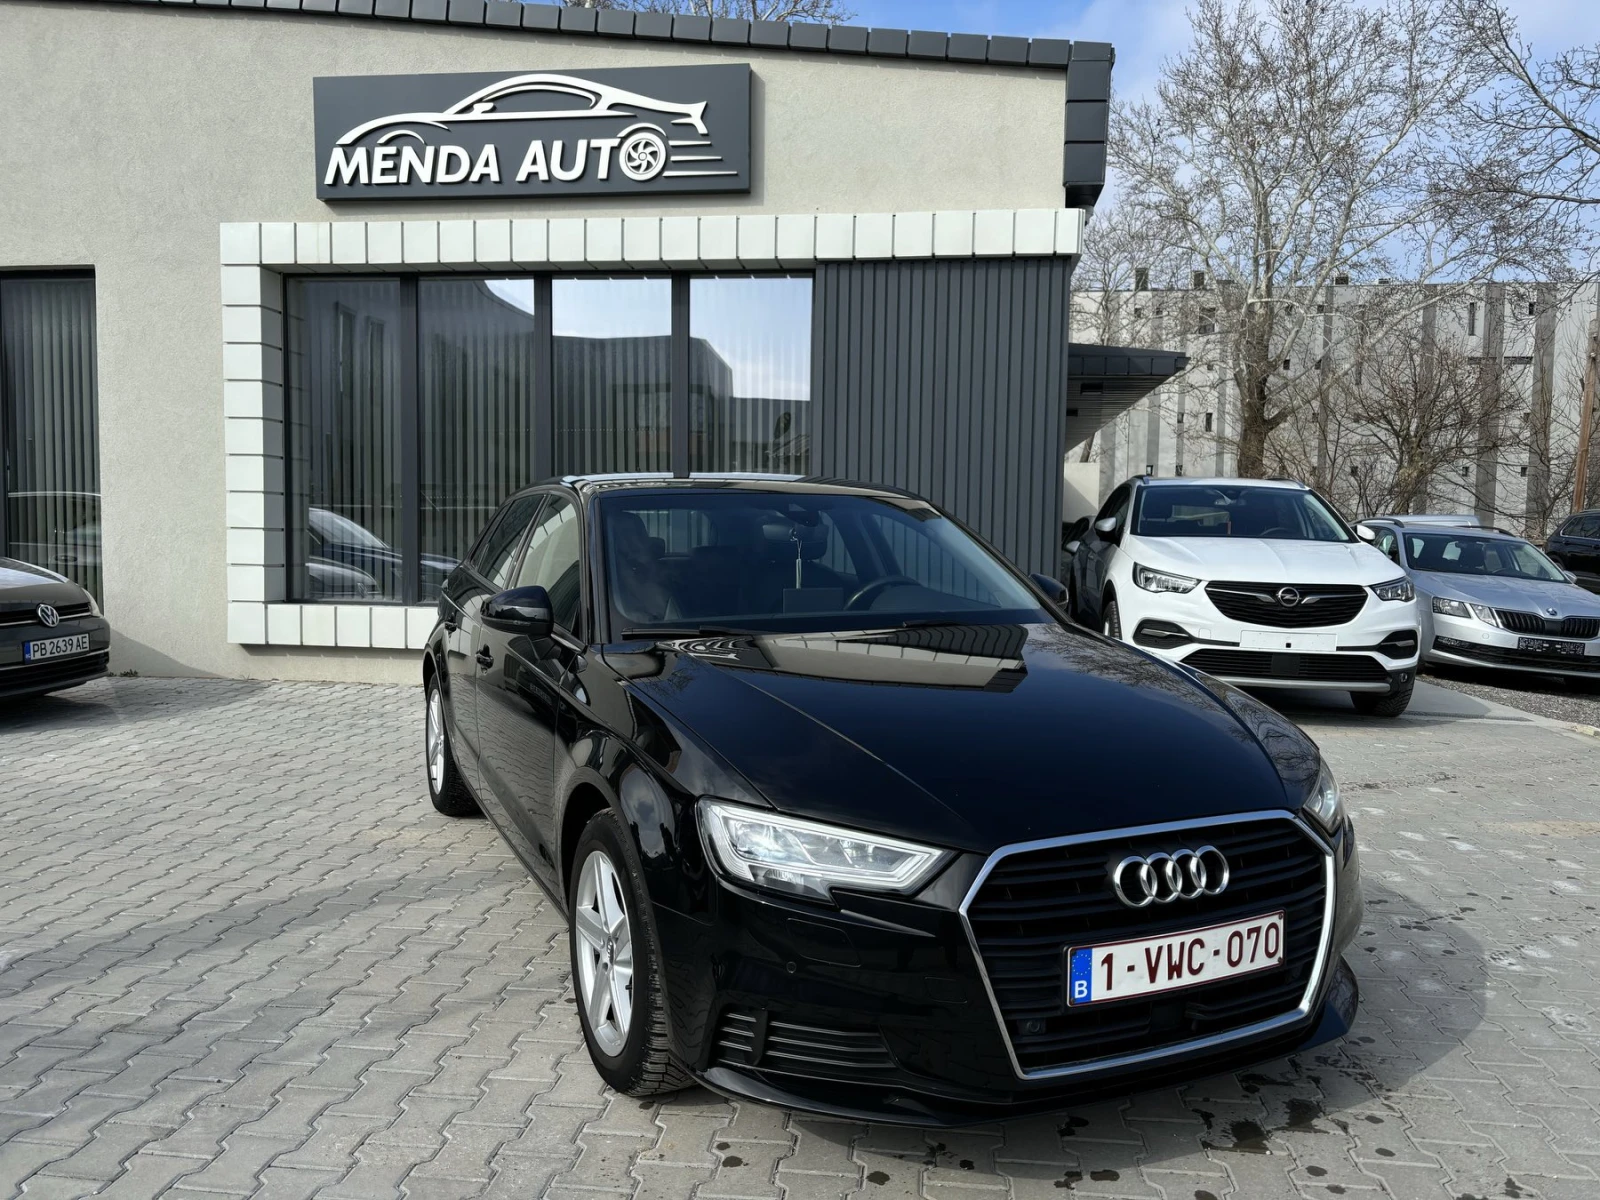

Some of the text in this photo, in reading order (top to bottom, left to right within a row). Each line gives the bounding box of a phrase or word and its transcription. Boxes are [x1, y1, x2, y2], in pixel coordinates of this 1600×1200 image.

[324, 142, 500, 185] MENDA
[49, 638, 74, 655] 2639
[75, 635, 88, 651] AE
[1074, 980, 1088, 999] B
